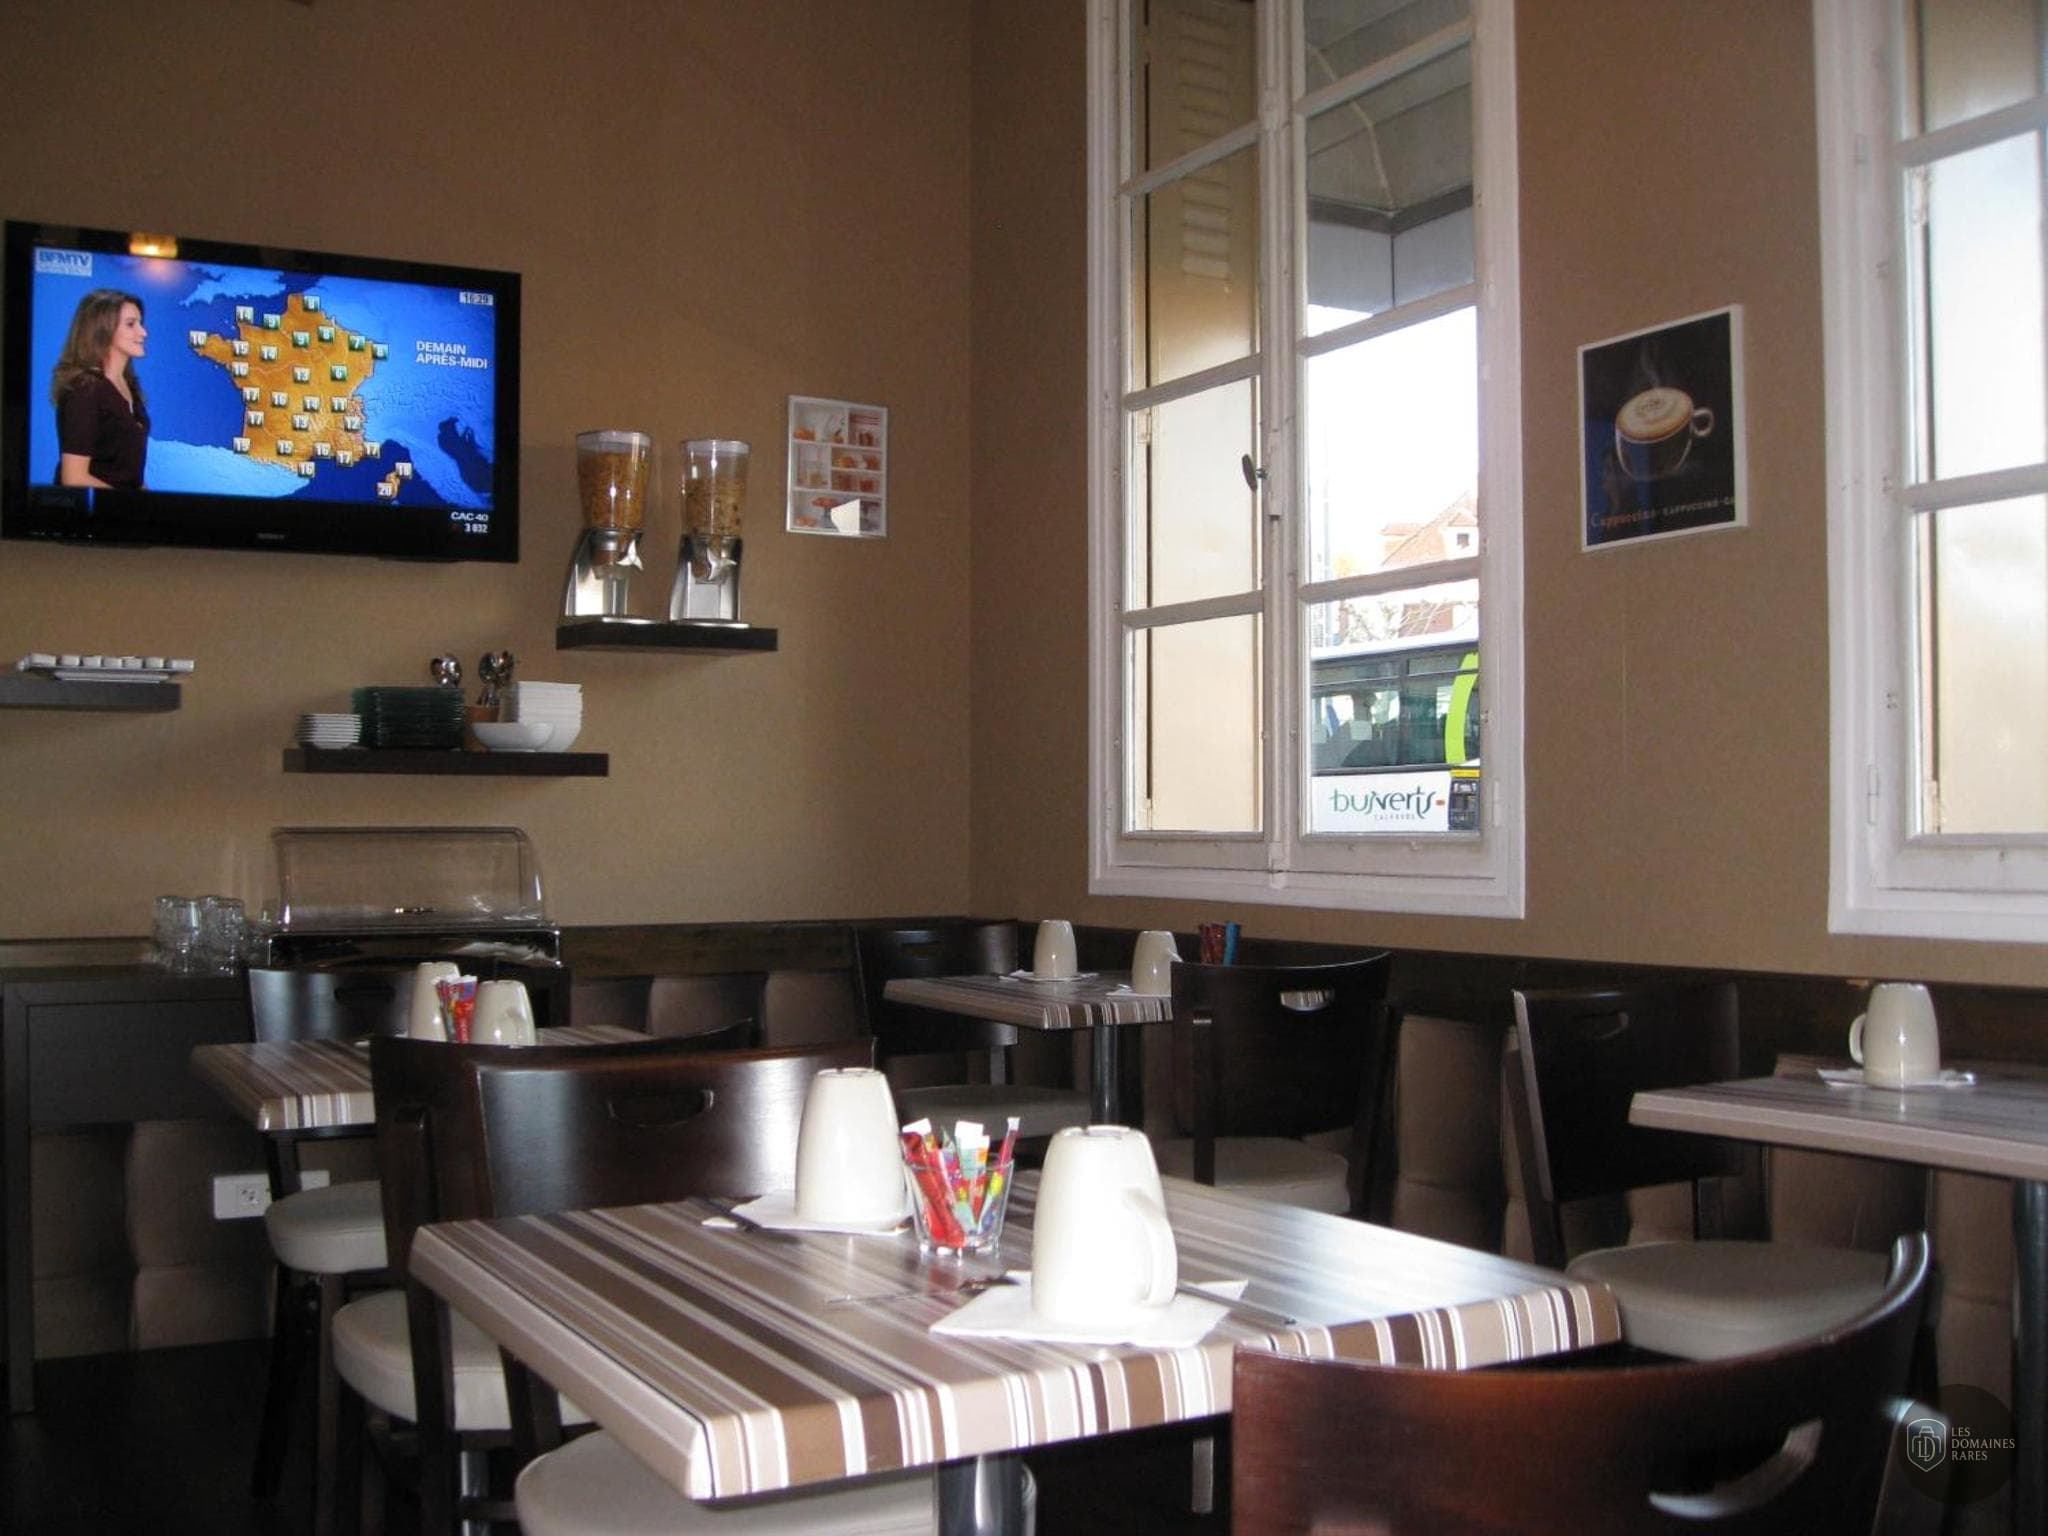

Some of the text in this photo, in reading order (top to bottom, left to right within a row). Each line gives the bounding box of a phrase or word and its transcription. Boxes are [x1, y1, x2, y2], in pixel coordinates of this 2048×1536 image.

[39, 250, 90, 267] BFMTV
[415, 340, 466, 355] DEMAIN
[450, 511, 489, 522] CAC 40
